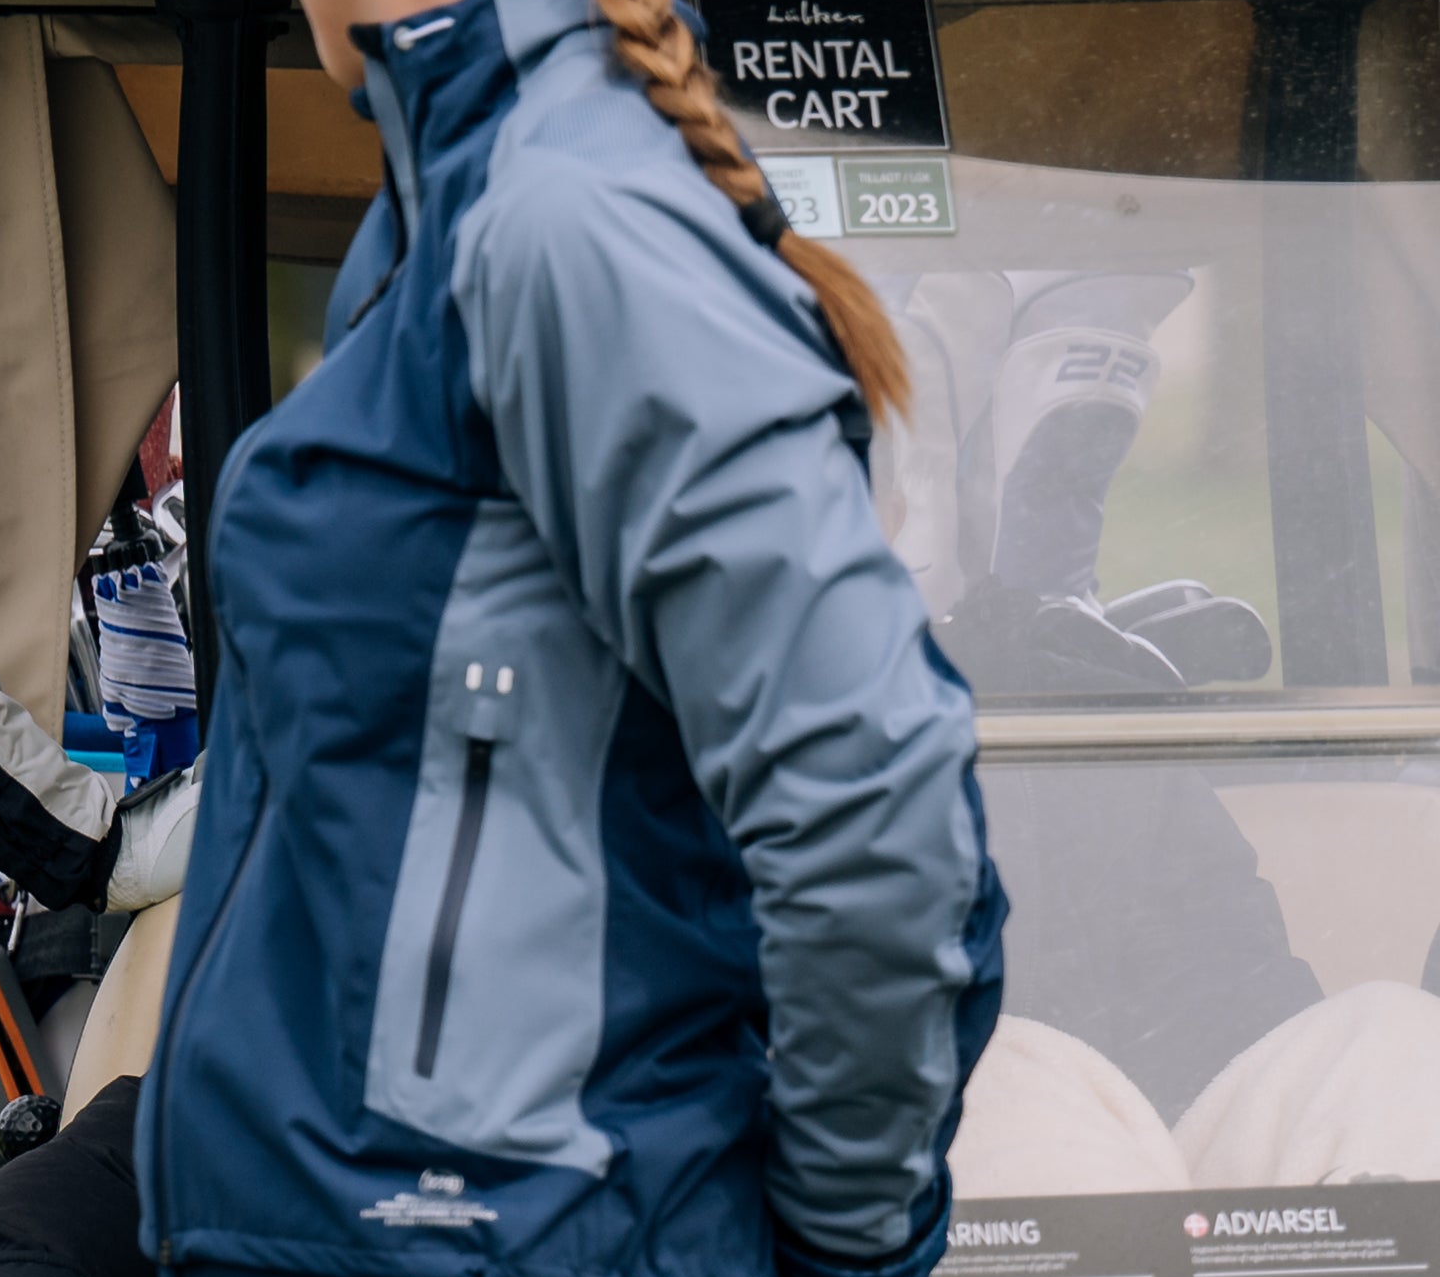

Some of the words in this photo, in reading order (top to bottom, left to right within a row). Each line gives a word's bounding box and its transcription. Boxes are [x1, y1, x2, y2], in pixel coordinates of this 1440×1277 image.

[733, 40, 911, 80] RENTAL
[766, 89, 889, 129] CART
[780, 196, 820, 224] 23
[857, 193, 940, 224] 2023
[1213, 1207, 1346, 1237] ADVARSEL
